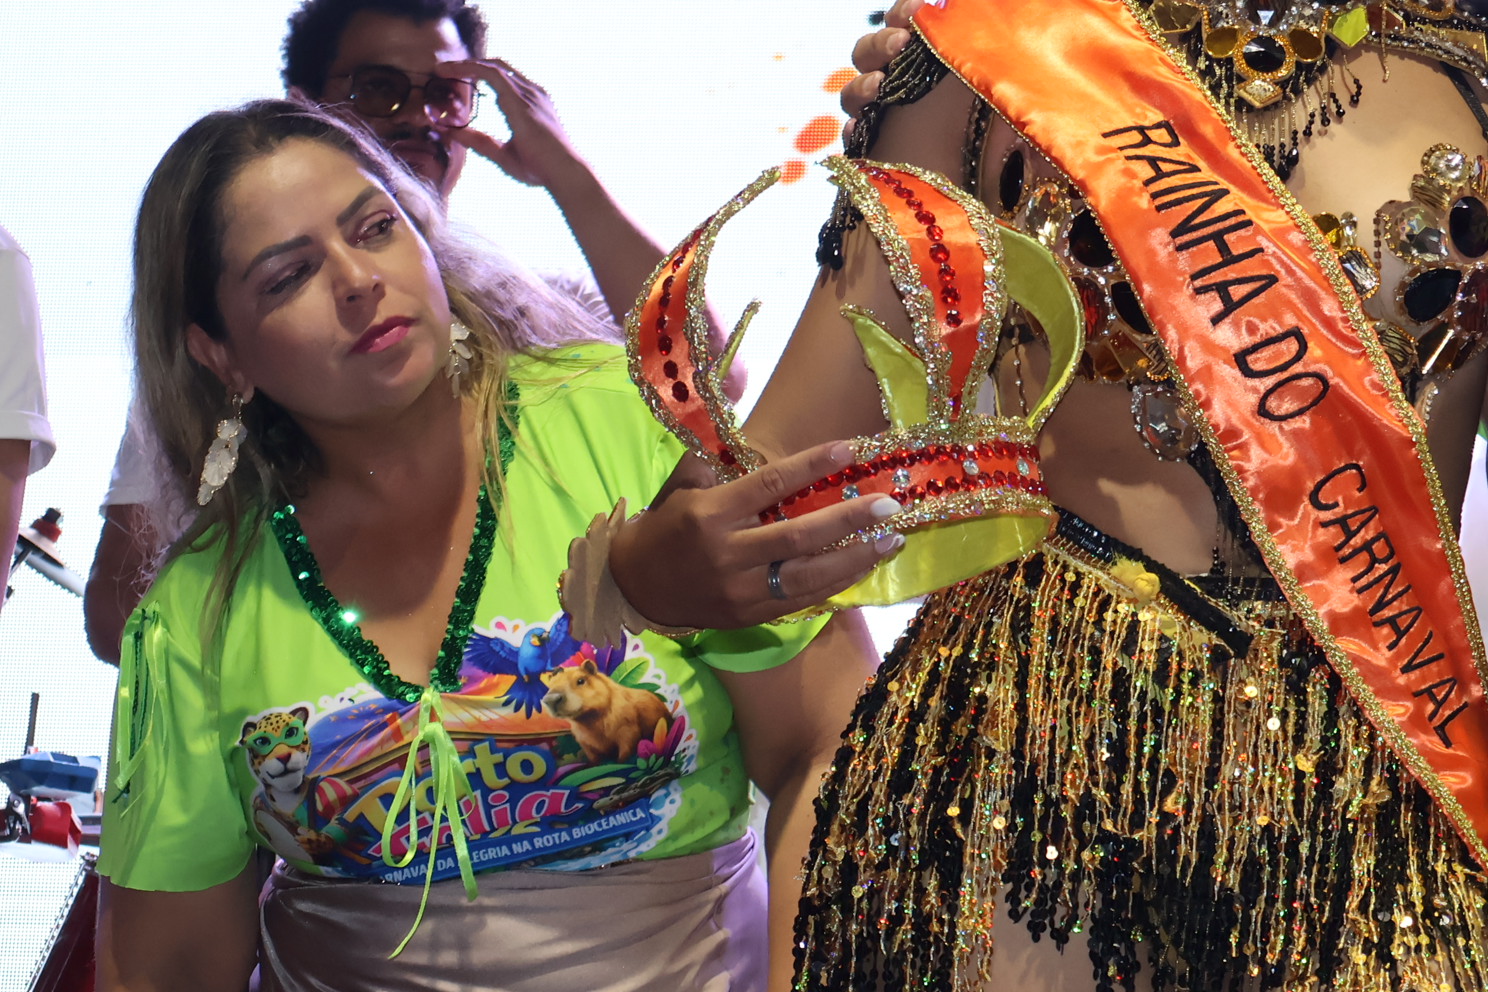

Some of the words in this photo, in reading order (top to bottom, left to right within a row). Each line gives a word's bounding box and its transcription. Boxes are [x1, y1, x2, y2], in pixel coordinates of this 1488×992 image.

[1101, 119, 1279, 328] RAINHA
[1233, 325, 1329, 422] DO
[1308, 460, 1471, 749] CARNAVAL
[436, 857, 455, 871] DA
[512, 840, 532, 855] NA
[533, 830, 571, 849] ROTA
